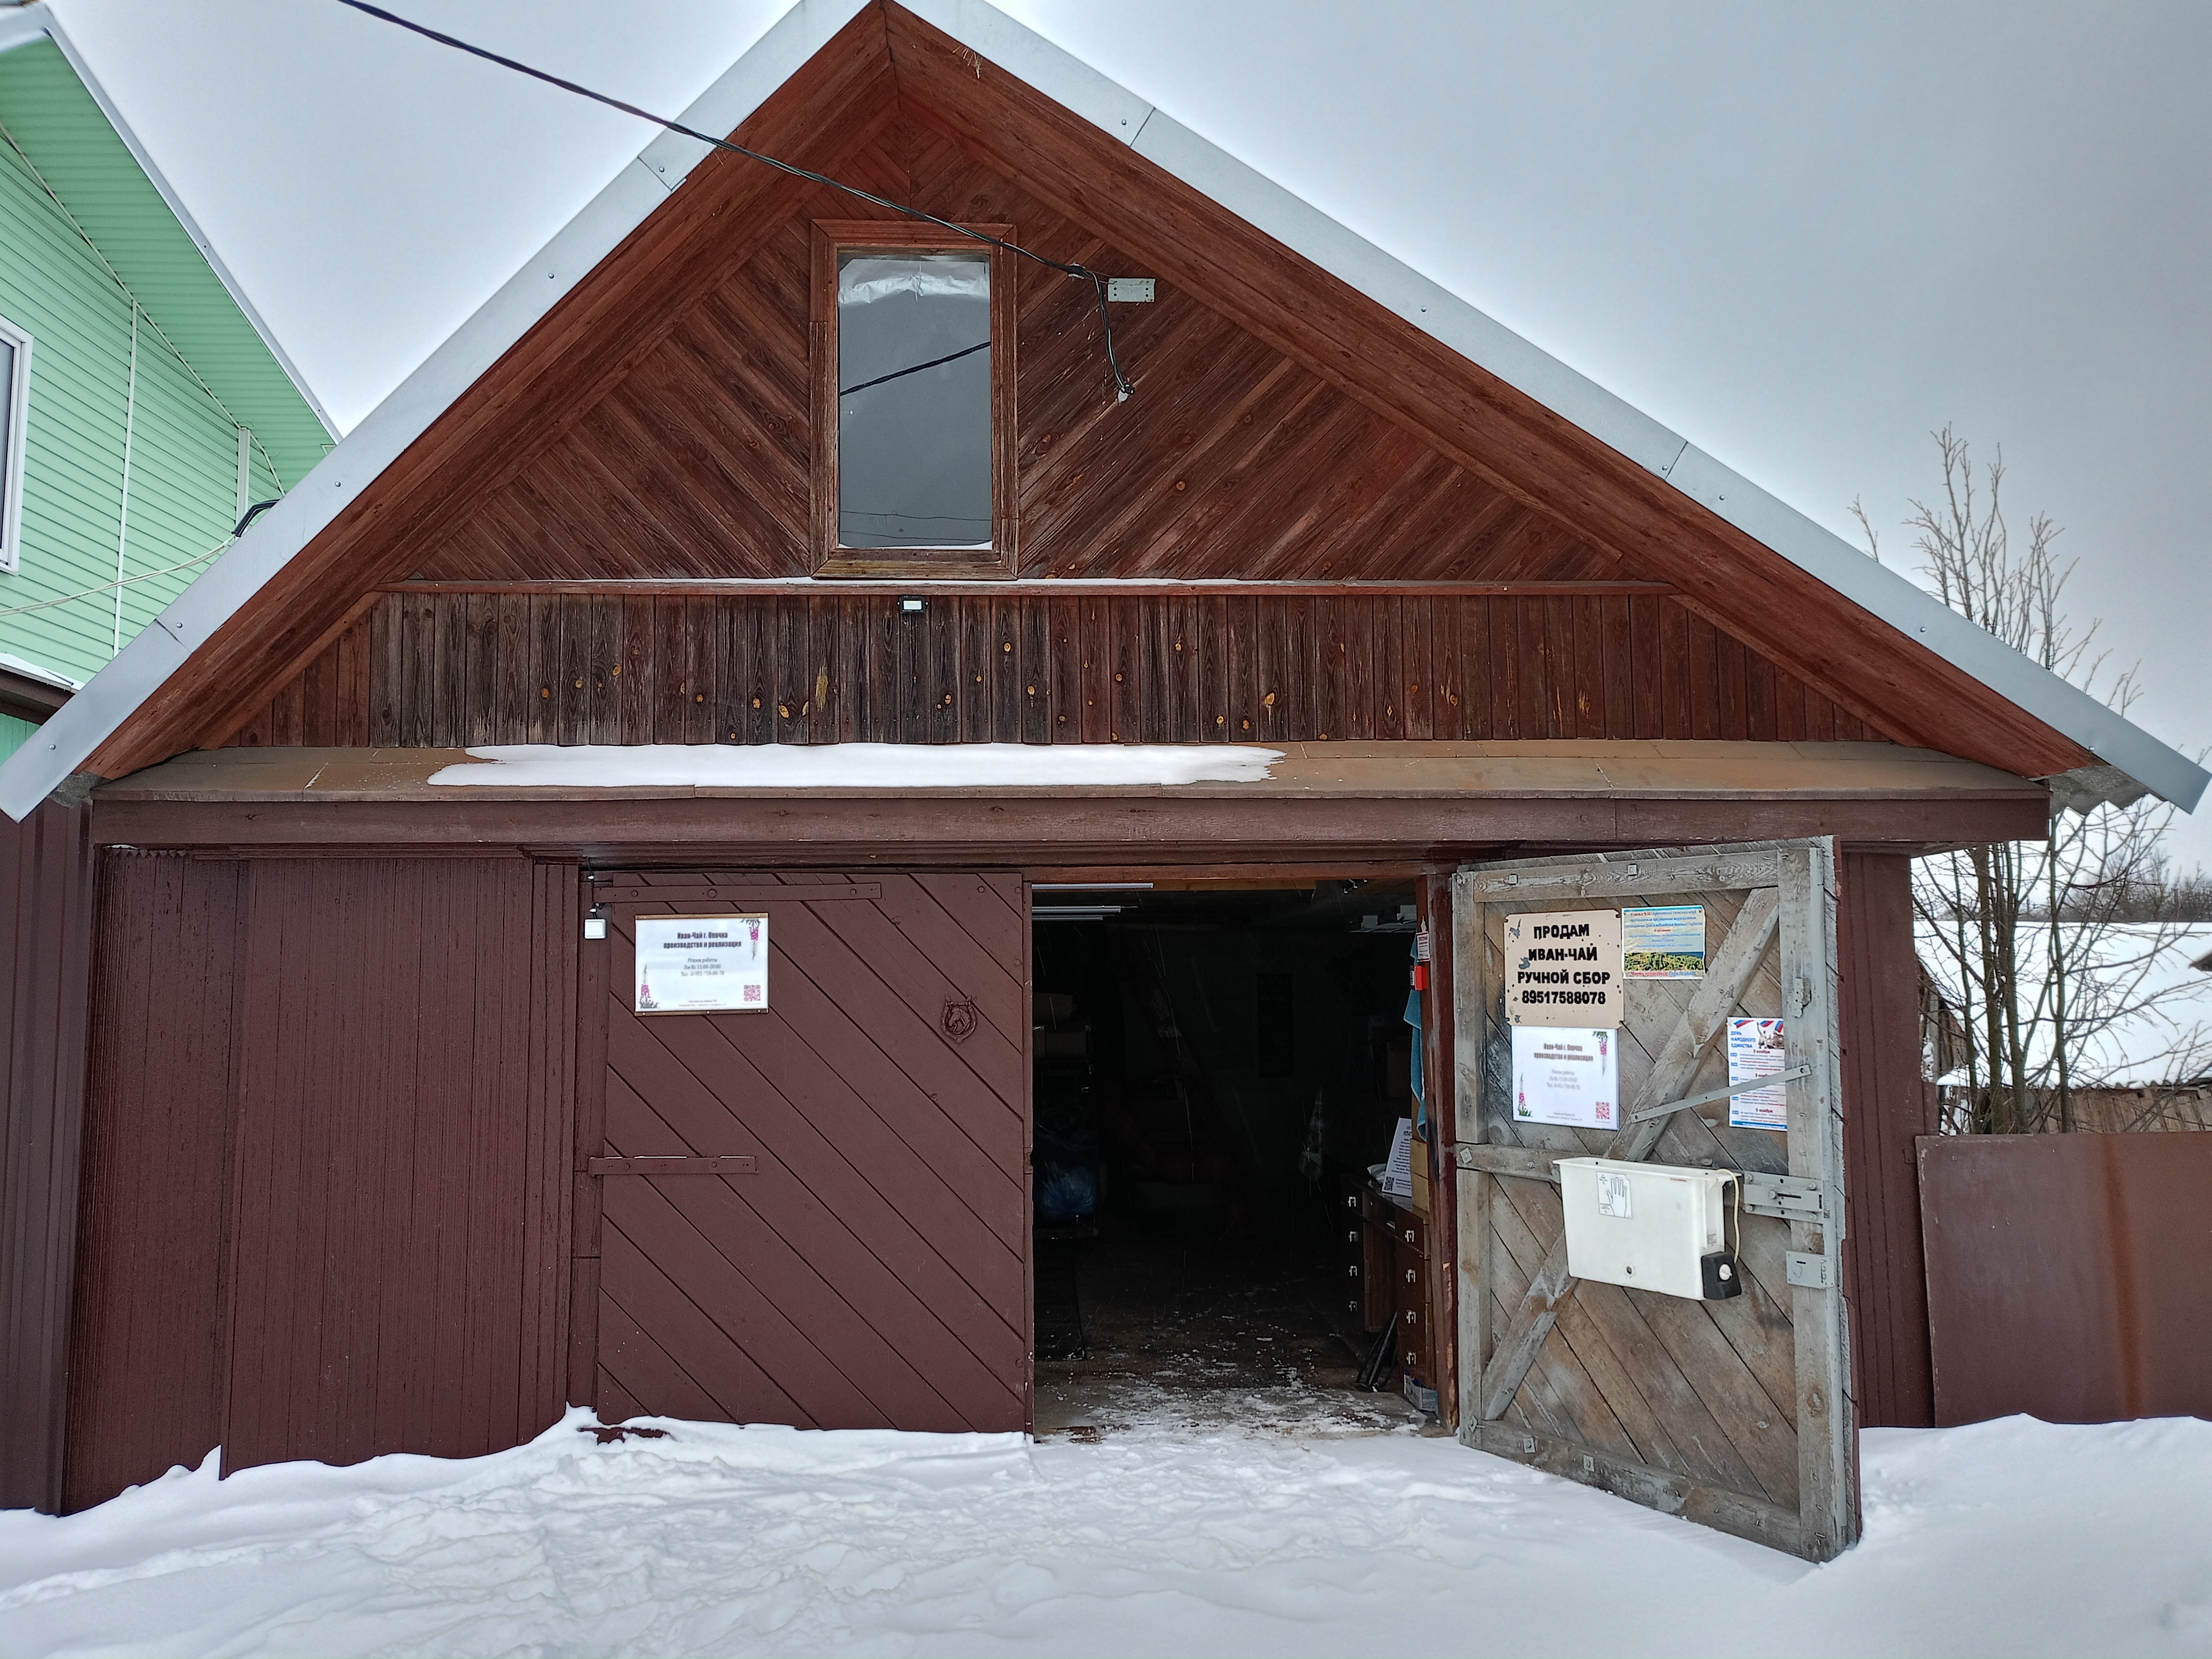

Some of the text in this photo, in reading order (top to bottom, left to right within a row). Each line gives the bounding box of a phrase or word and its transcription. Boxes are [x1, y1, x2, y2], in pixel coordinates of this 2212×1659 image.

[1534, 924, 1590, 940] ПРОДАМ
[1517, 969, 1610, 984] РУЧНОЙ СБОР
[1522, 990, 1606, 1005] 89517588078
